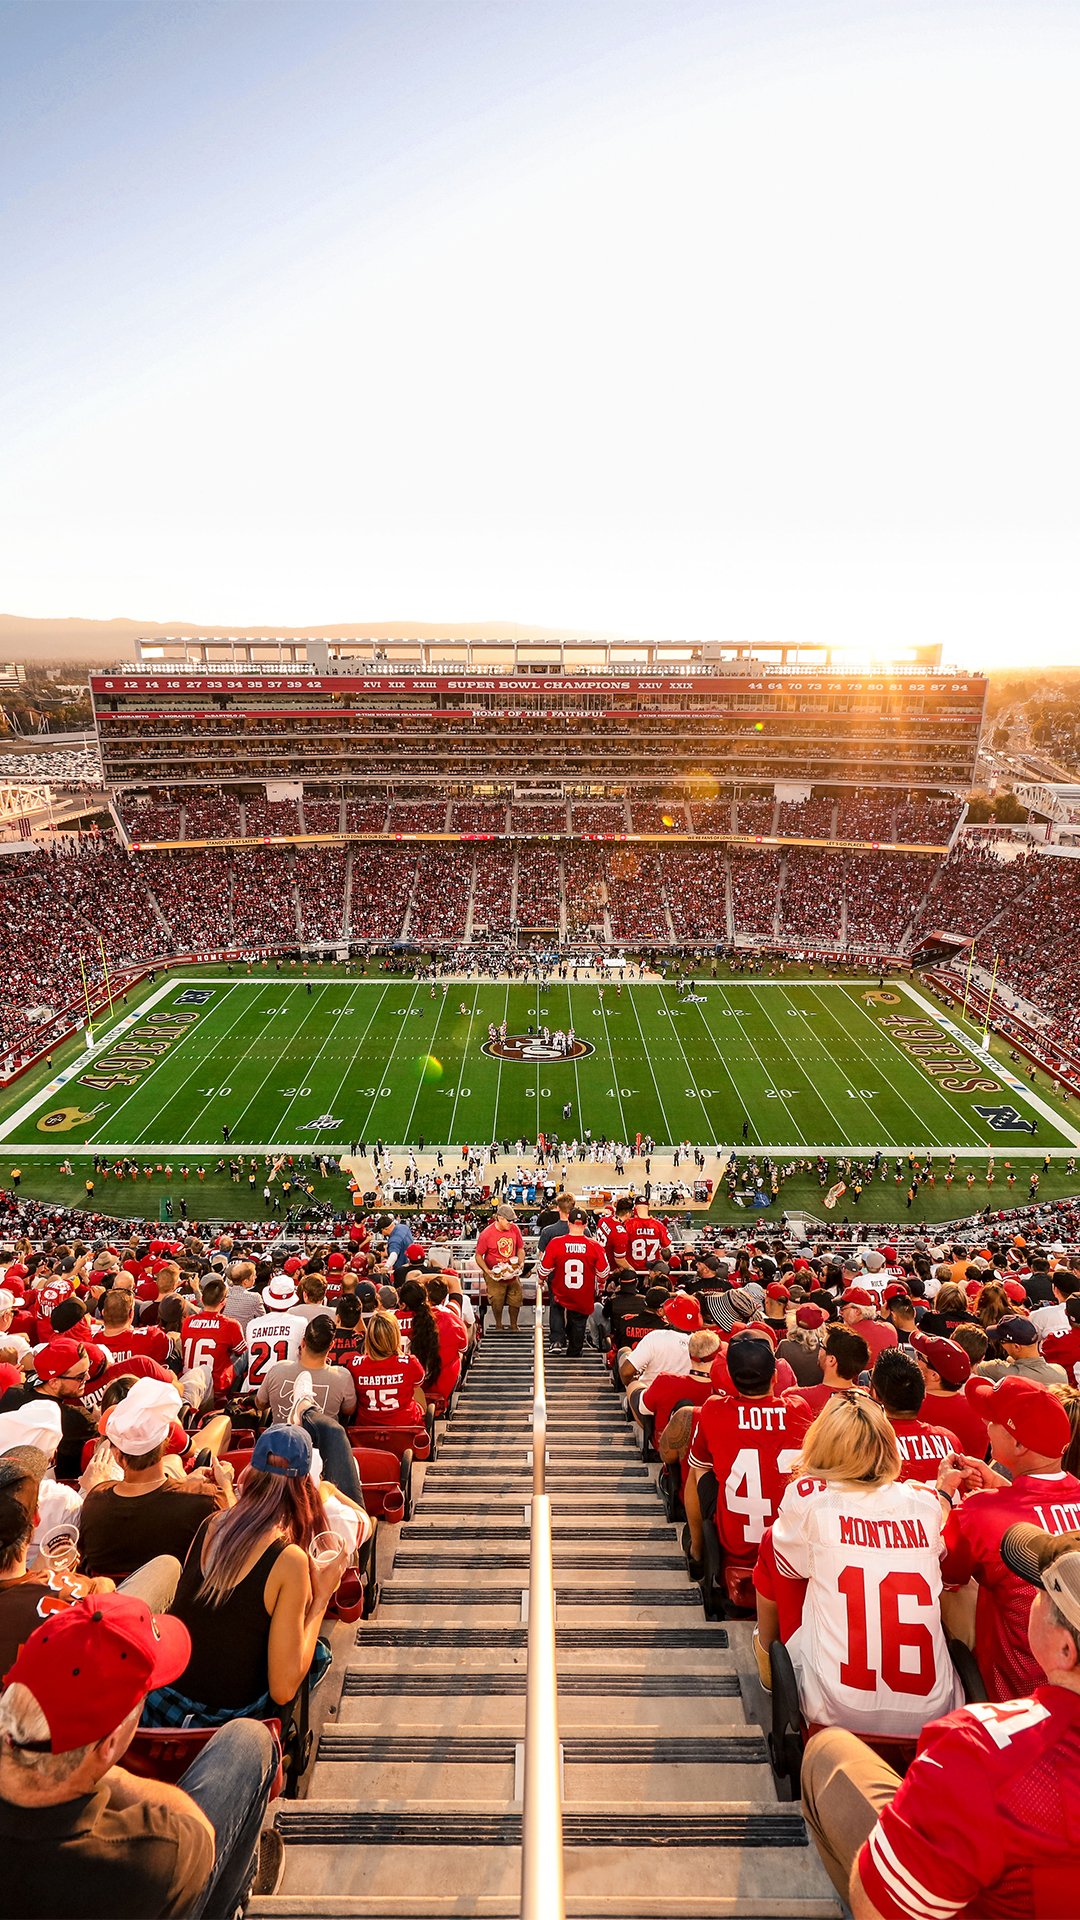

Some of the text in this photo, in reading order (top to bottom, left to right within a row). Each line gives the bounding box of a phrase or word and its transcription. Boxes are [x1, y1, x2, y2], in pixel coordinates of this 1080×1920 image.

[447, 681, 495, 689] SUPER
[197, 953, 223, 962] HOME
[100, 1027, 126, 1045] CATCH
[77, 1012, 200, 1091] 49ERS
[877, 1014, 1005, 1093] 49ERS
[950, 1030, 1005, 1072] CRUCIAL CATCH
[205, 1087, 232, 1097] 10
[282, 1087, 312, 1097] 20
[363, 1087, 392, 1097] 30
[443, 1088, 472, 1097] 40
[525, 1088, 551, 1098] 50
[605, 1088, 631, 1098] 40
[685, 1088, 711, 1098] 30
[764, 1088, 792, 1098] 20
[845, 1088, 873, 1098] 10
[636, 1228, 655, 1236] CLARK
[565, 1243, 587, 1254] YOUNG
[631, 1238, 660, 1262] 87
[564, 1259, 584, 1289] 8
[188, 1319, 220, 1329] MONTANA
[252, 1326, 291, 1339] SANDERS
[183, 1338, 217, 1377] 16
[249, 1340, 289, 1386] 21
[358, 1374, 404, 1386] CRABTREE
[366, 1389, 400, 1412] 15
[738, 1406, 787, 1431] LOTT
[896, 1435, 955, 1461] NTANA
[839, 1515, 930, 1549] MONTANA
[837, 1565, 937, 1697] 16
